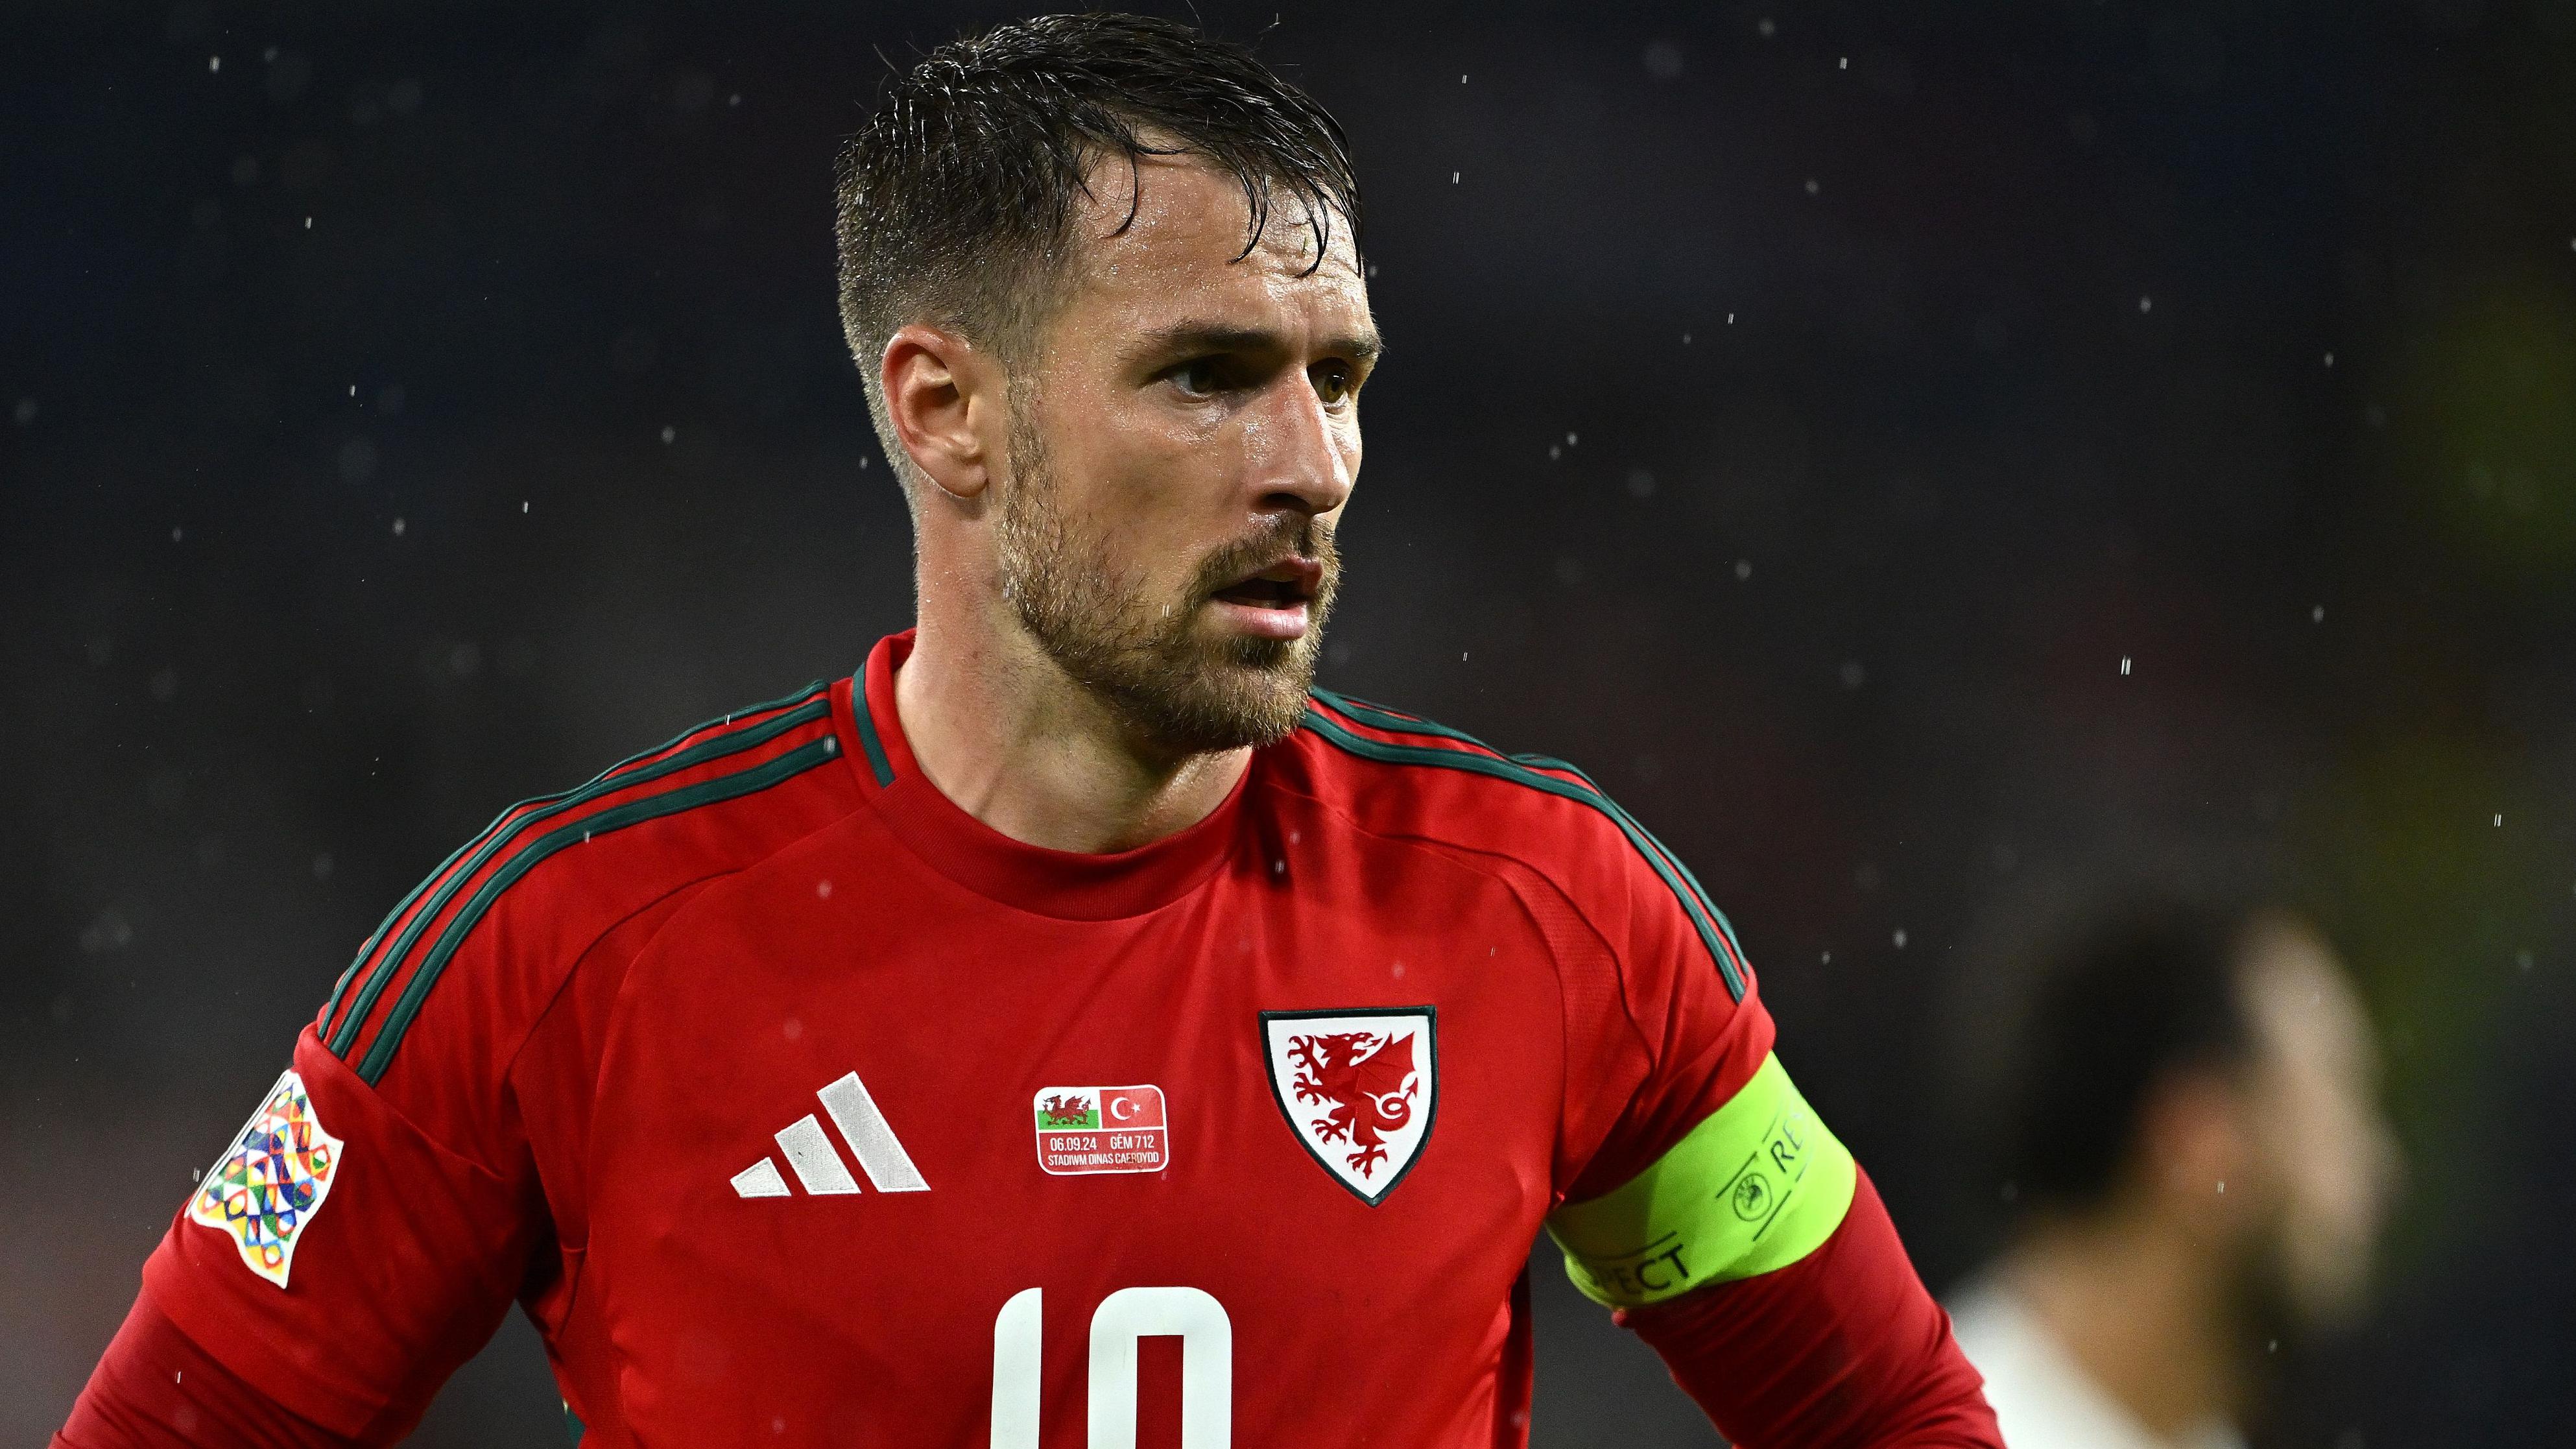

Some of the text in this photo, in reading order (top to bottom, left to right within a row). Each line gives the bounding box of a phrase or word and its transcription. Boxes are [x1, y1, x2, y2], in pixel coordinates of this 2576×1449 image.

[1048, 1151, 1159, 1166] STADIWM DINAS CAERDYDD
[1050, 1136, 1097, 1151] 06.09.24
[1134, 1135, 1154, 1149] 712
[1770, 1117, 1804, 1174] RE
[990, 1287, 1232, 1449] 10
